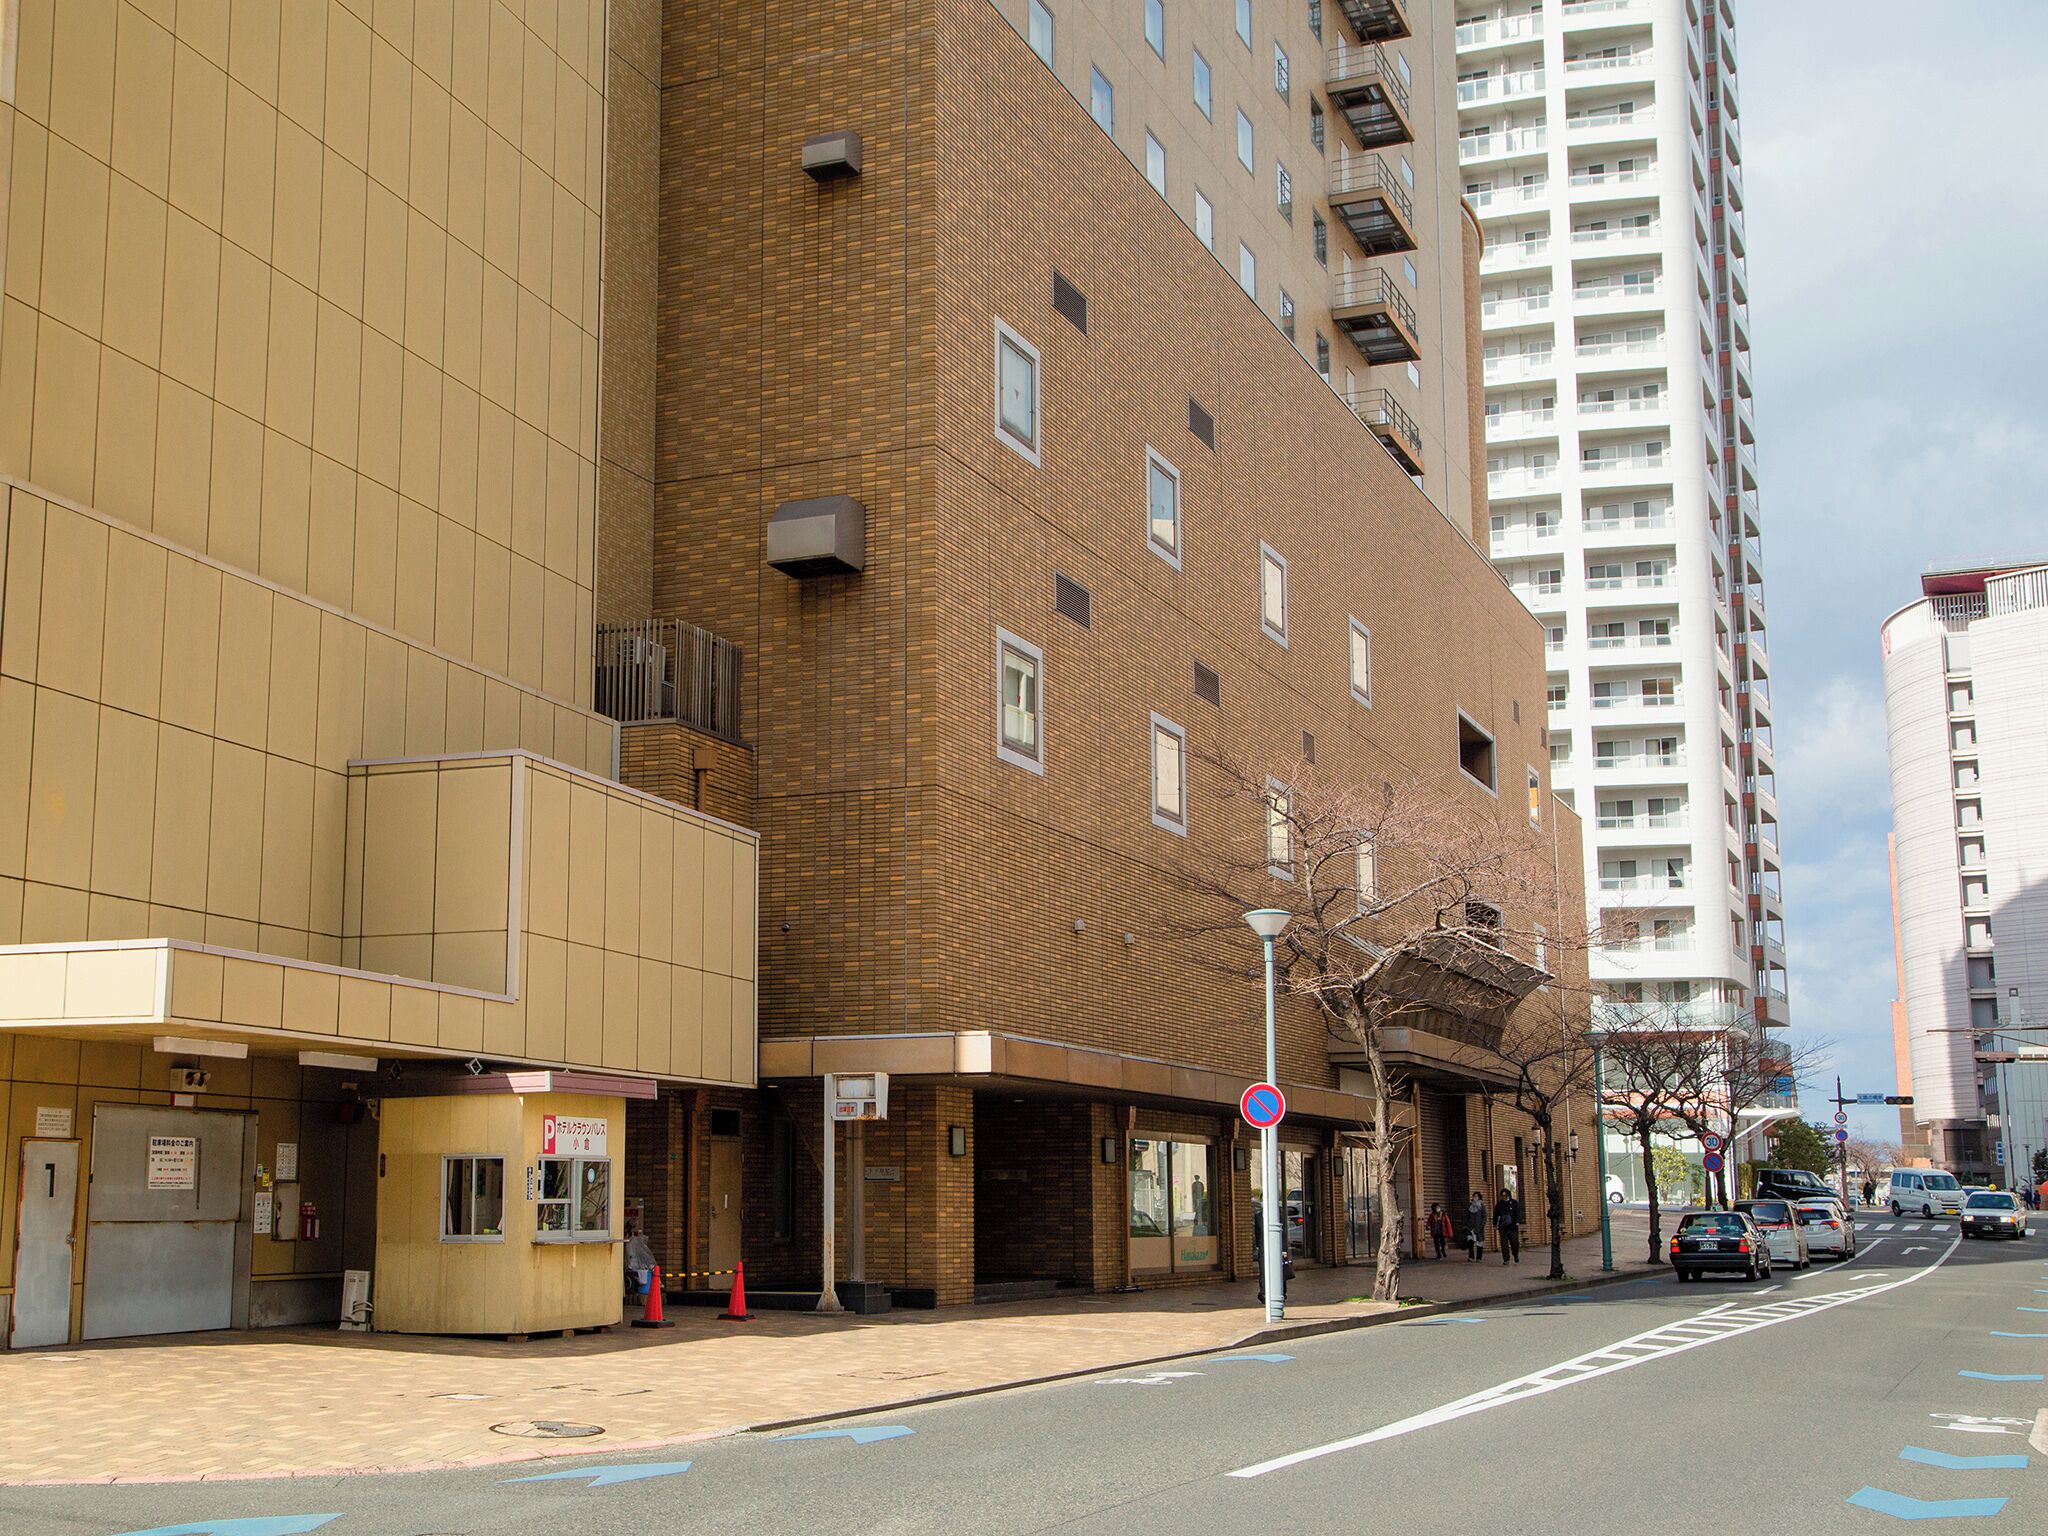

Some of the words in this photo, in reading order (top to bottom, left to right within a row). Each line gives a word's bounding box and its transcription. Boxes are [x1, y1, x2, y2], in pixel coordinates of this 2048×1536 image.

[544, 1119, 555, 1150] P
[557, 1121, 606, 1136] ホテルクラウンパレス
[573, 1137, 590, 1151] 小倉
[1705, 1136, 1719, 1147] 30
[45, 1163, 56, 1198] 1
